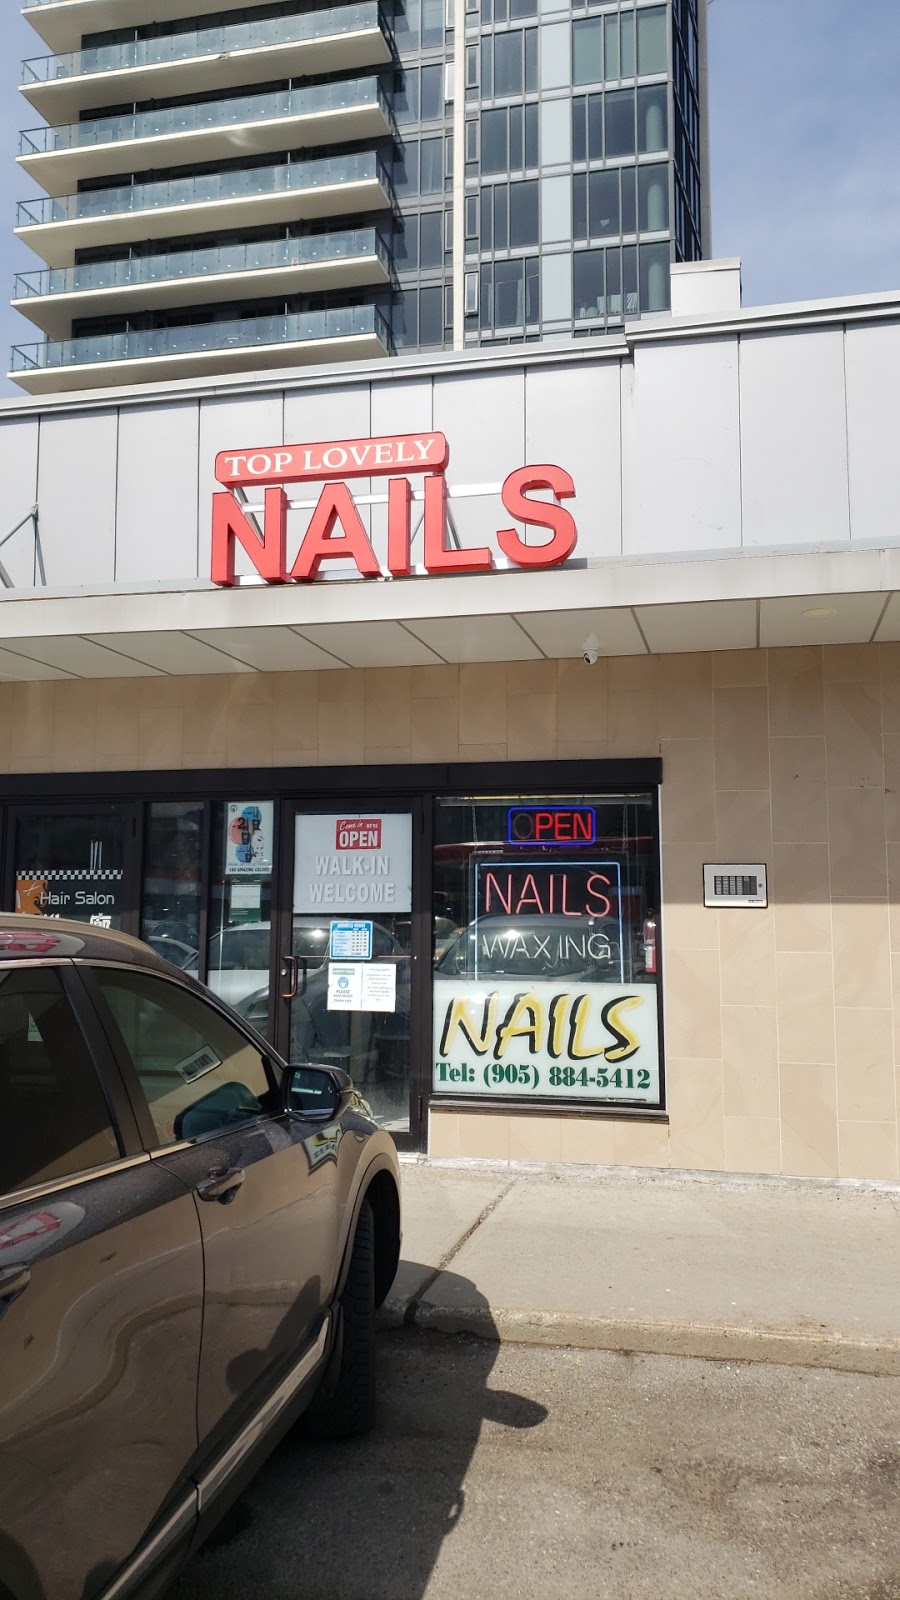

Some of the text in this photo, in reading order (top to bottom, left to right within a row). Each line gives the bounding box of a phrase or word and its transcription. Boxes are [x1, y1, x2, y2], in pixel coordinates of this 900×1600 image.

[225, 438, 436, 477] TOP LOVELY
[210, 463, 578, 587] NAILS
[339, 820, 356, 831] Come
[357, 820, 364, 828] in
[339, 830, 378, 848] OPEN
[512, 812, 592, 841] OPEN
[315, 855, 390, 876] WALK-IN
[40, 891, 115, 905] Hair Salon
[309, 882, 396, 903] WELCOME
[485, 872, 611, 918] NAILS
[482, 933, 612, 960] WAXING
[439, 990, 645, 1064] NAILS
[435, 1062, 651, 1090] Tel: (905) 884-5412
